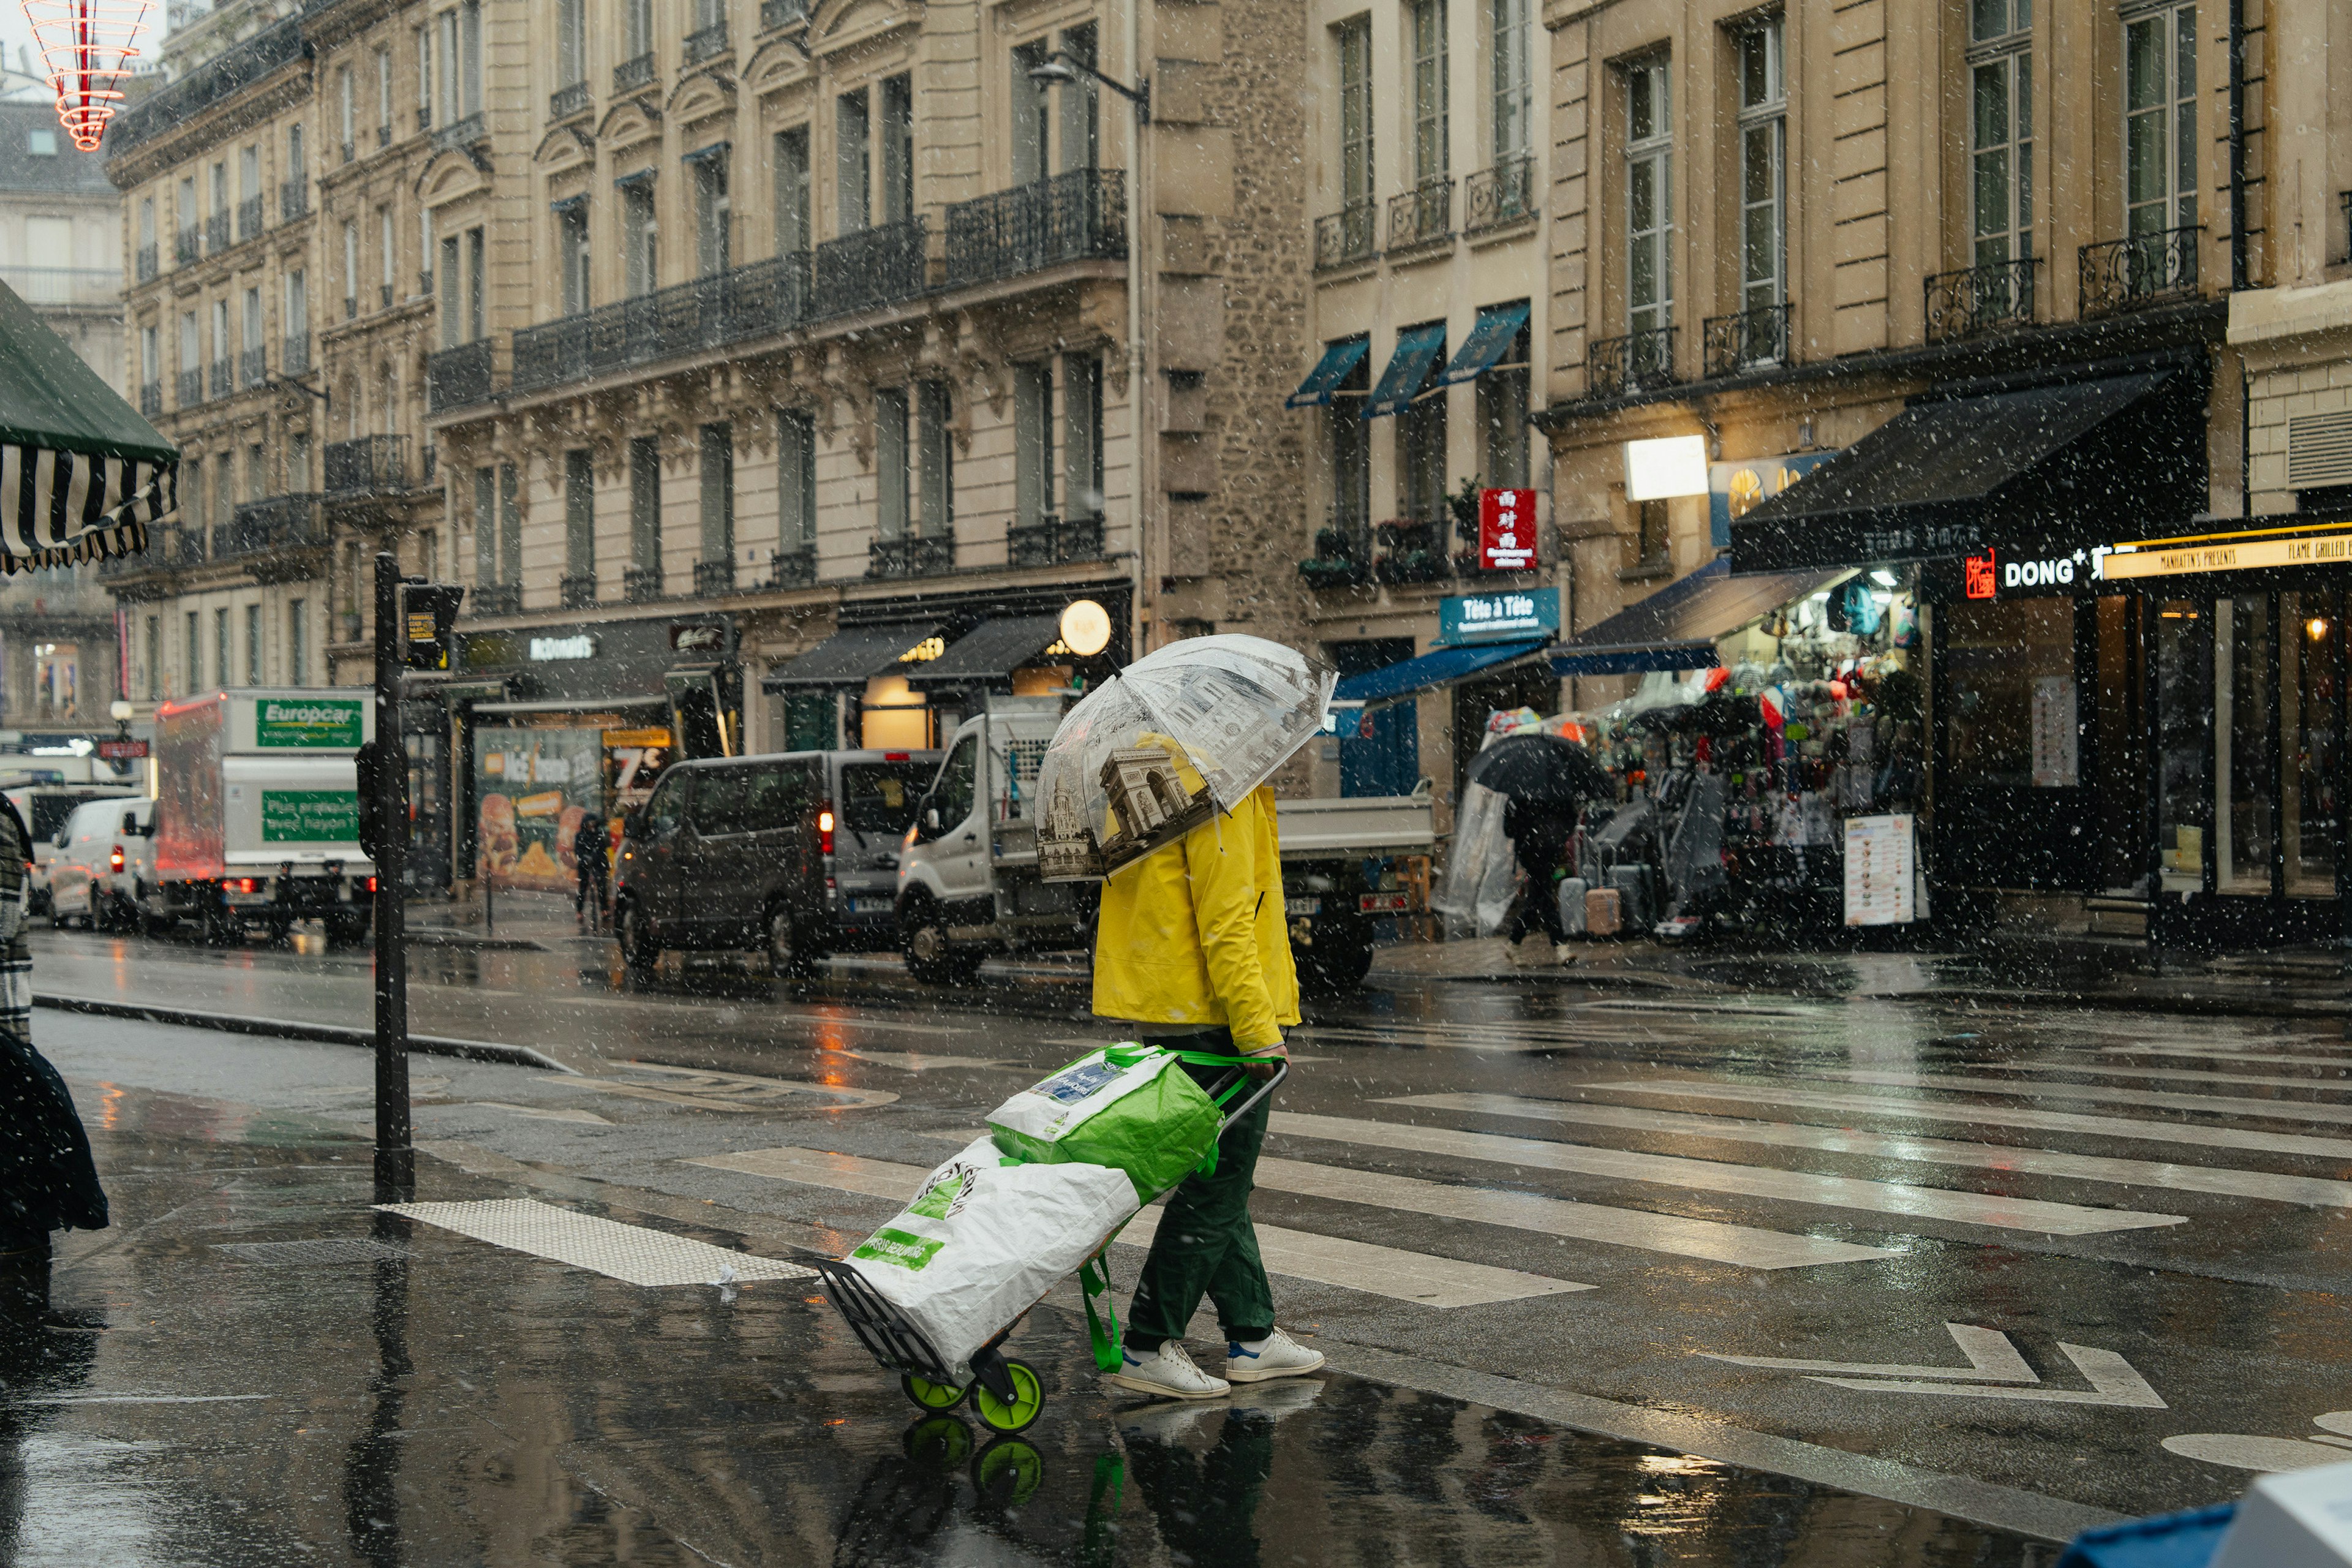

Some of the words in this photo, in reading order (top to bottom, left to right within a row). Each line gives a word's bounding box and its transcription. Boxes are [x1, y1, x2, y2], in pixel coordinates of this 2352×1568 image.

[2161, 553, 2201, 570] MANHATTN'S
[2204, 548, 2236, 566] PRESENTS
[2288, 542, 2310, 559] FLAME
[2315, 541, 2344, 558] GRILLED
[265, 704, 353, 726] Europcar
